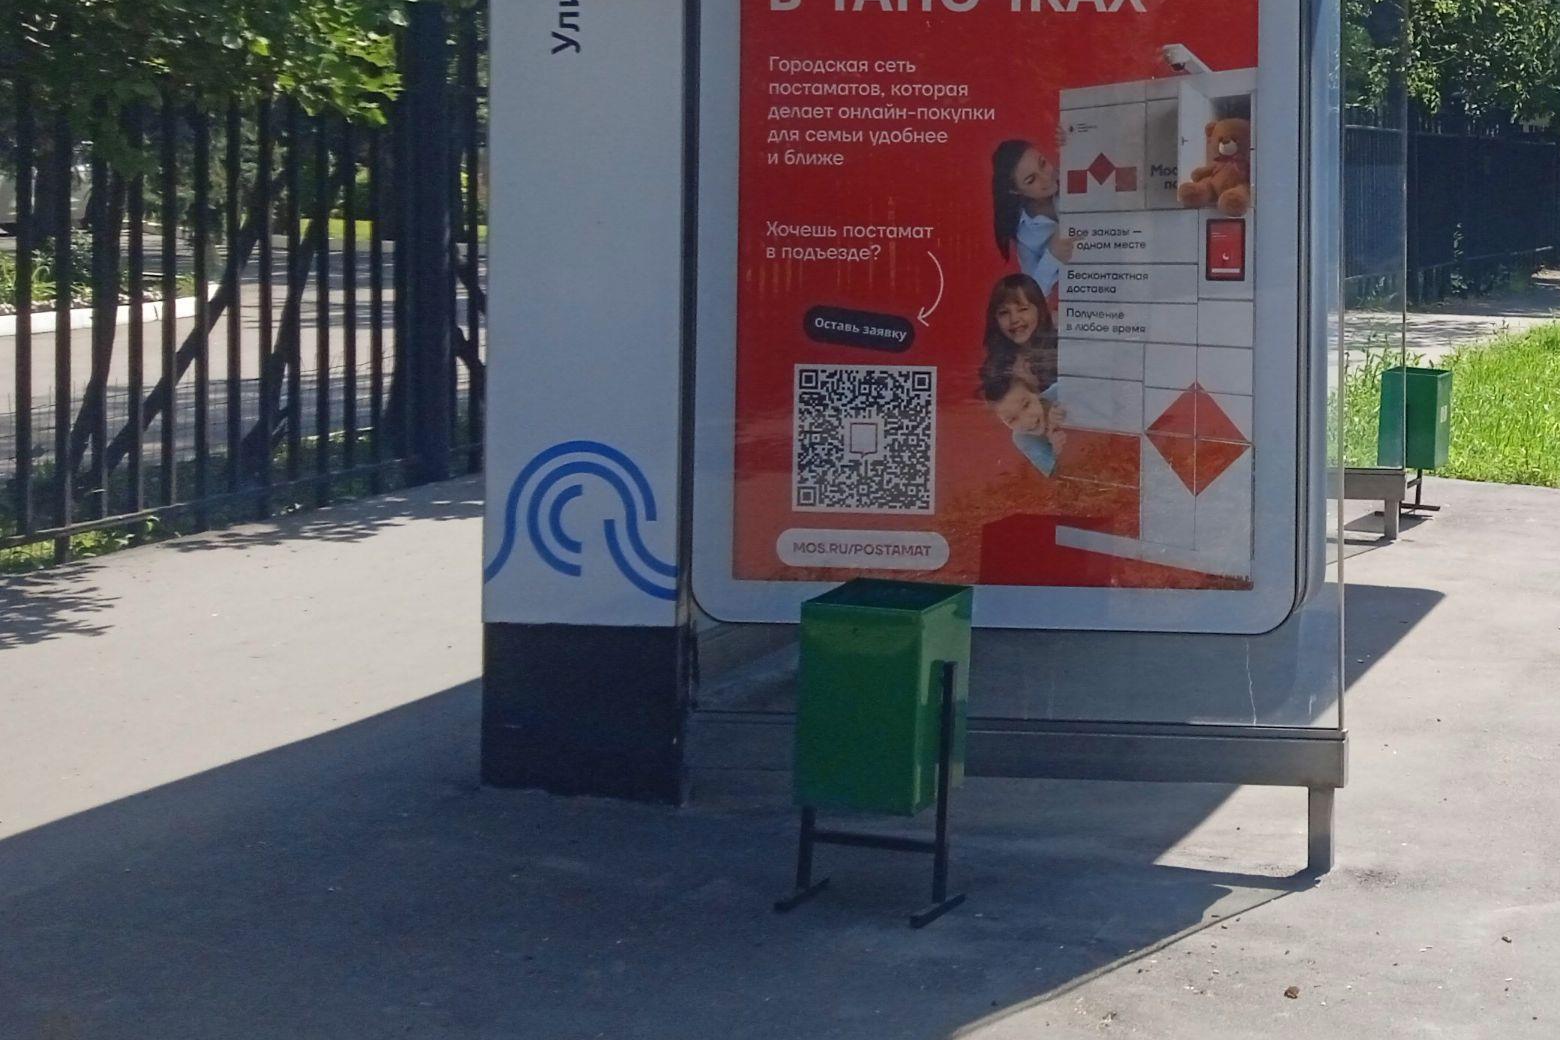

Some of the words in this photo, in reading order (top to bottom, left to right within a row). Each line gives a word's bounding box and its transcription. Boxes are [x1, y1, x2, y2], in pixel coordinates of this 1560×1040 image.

[768, 57, 869, 75] Городская
[874, 60, 916, 72] сеть
[768, 83, 885, 97] постаматов,
[891, 84, 969, 99] которая
[767, 106, 834, 120] делает
[838, 103, 995, 123] онлайн-покупки
[767, 129, 799, 144] для
[804, 130, 863, 142] семьи
[869, 128, 949, 146] удобнее
[767, 153, 779, 165] и
[784, 150, 844, 166] ближе
[766, 221, 838, 237] Хочешь
[843, 226, 934, 239] постамат
[1068, 227, 1089, 238] Все
[1092, 228, 1130, 237] заказы
[766, 247, 776, 259] в
[782, 244, 882, 261] подъезде?
[1113, 241, 1146, 250] месте
[1067, 270, 1149, 281] Бесконтактная
[1066, 285, 1117, 295] доставка
[1066, 308, 1125, 320] Получение
[814, 317, 860, 333] Оставь
[862, 324, 908, 343] заявку
[792, 541, 932, 557] MOS.RU/POSTAMAT
